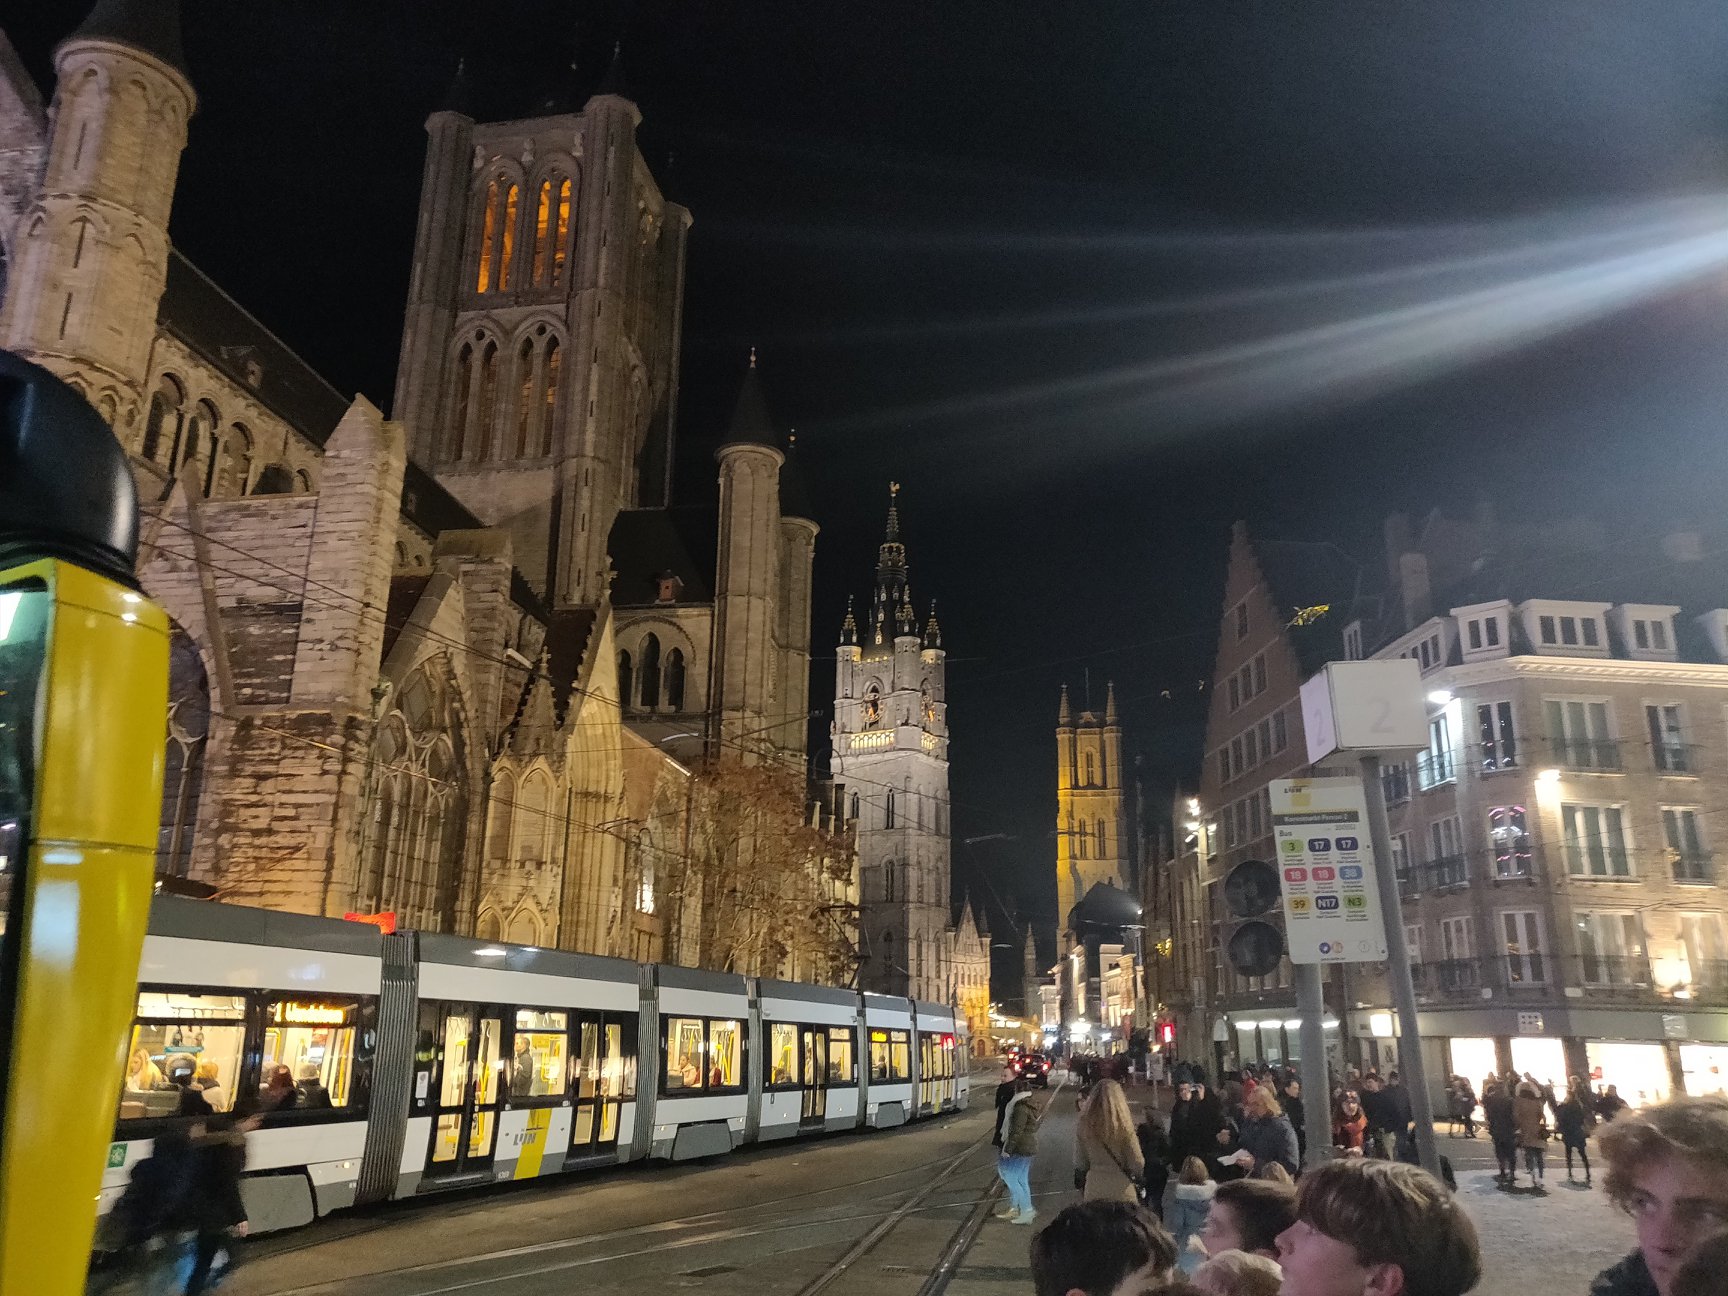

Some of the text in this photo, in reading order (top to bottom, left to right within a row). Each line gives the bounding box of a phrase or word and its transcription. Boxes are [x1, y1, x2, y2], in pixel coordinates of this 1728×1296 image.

[1368, 697, 1395, 734] 2
[1288, 842, 1295, 851] 3
[1313, 841, 1325, 850] 17
[1341, 840, 1352, 849] 17
[1289, 870, 1302, 880] 18
[1317, 870, 1329, 879] 18
[1292, 899, 1306, 909] 39
[1317, 898, 1337, 908] N17
[1347, 897, 1362, 907] N3
